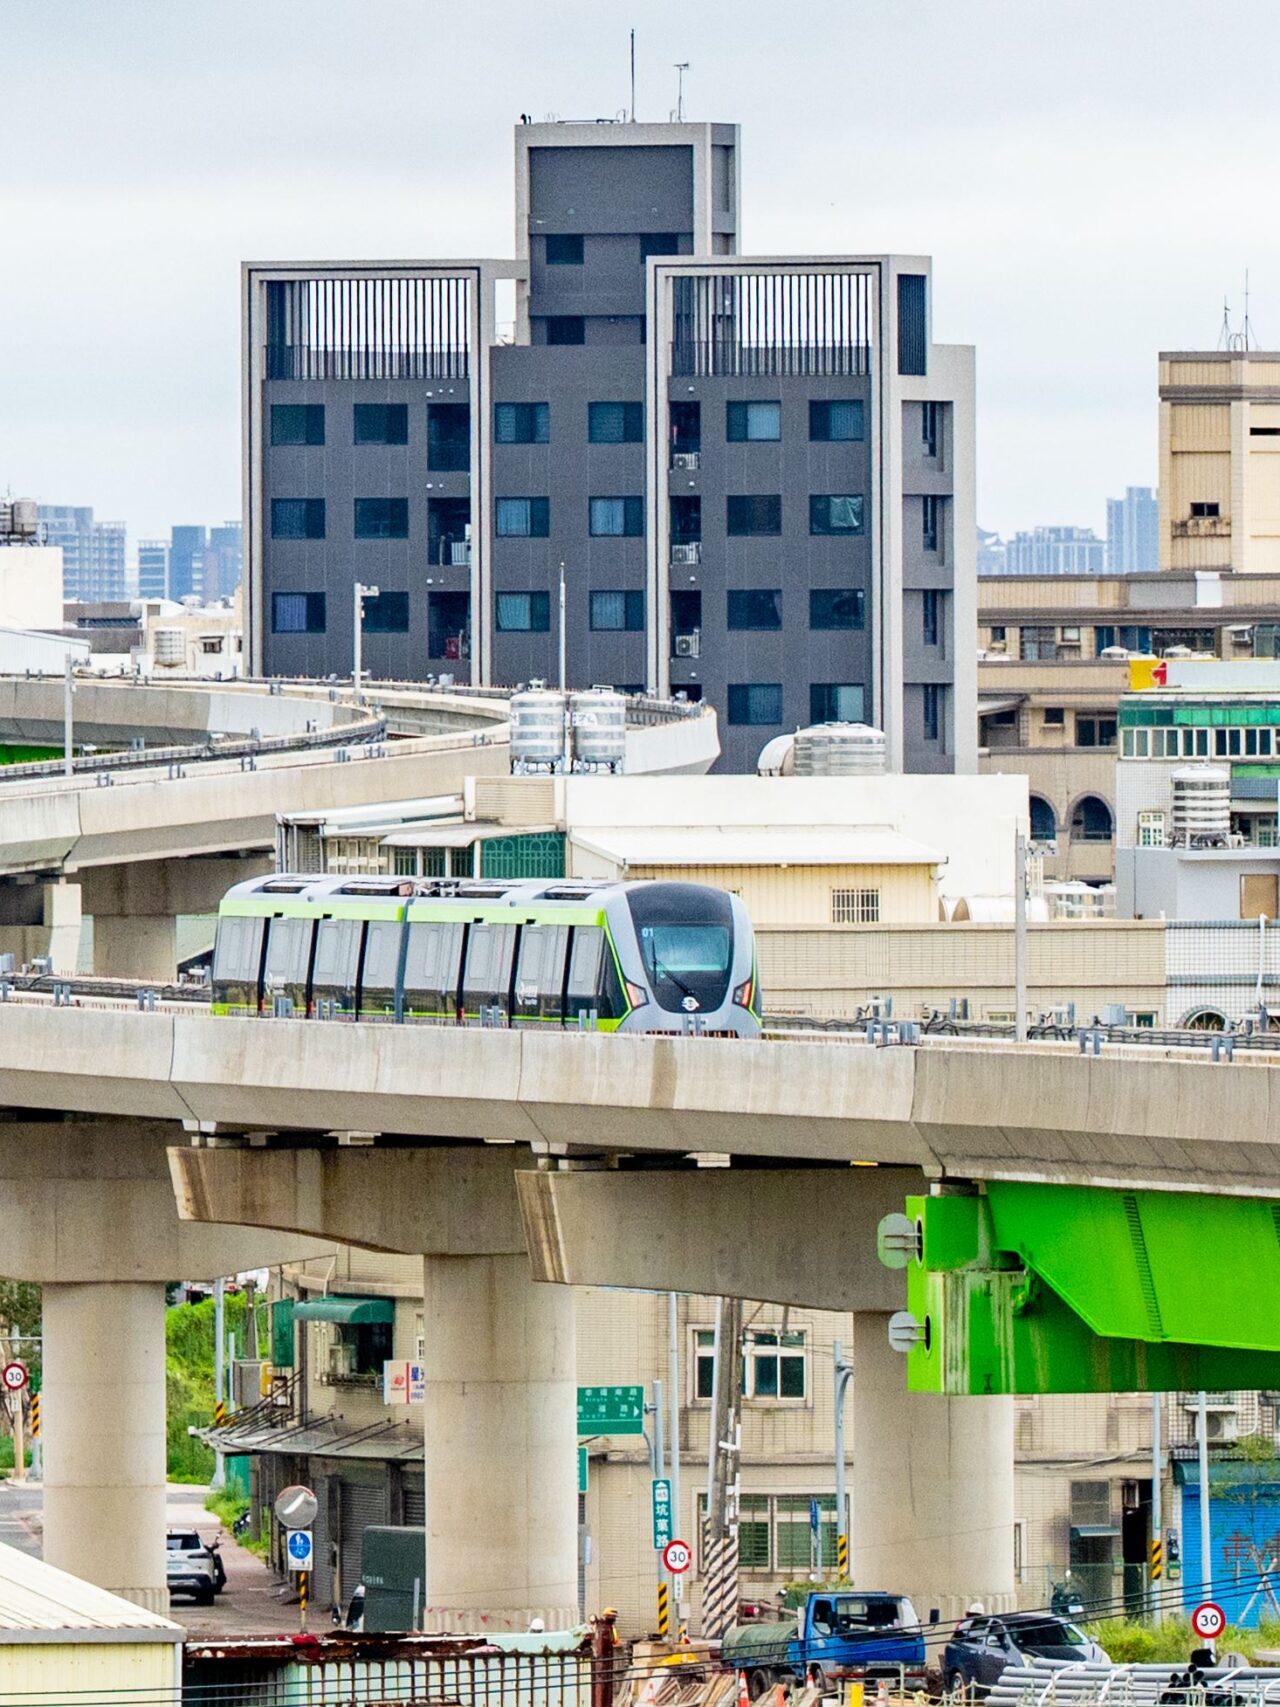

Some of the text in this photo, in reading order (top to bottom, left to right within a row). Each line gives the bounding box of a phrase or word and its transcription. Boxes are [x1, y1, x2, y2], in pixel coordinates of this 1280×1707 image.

[642, 927, 654, 937] 01
[8, 1371, 22, 1382] 30
[670, 1551, 686, 1563] 30
[1200, 1615, 1219, 1627] 30
